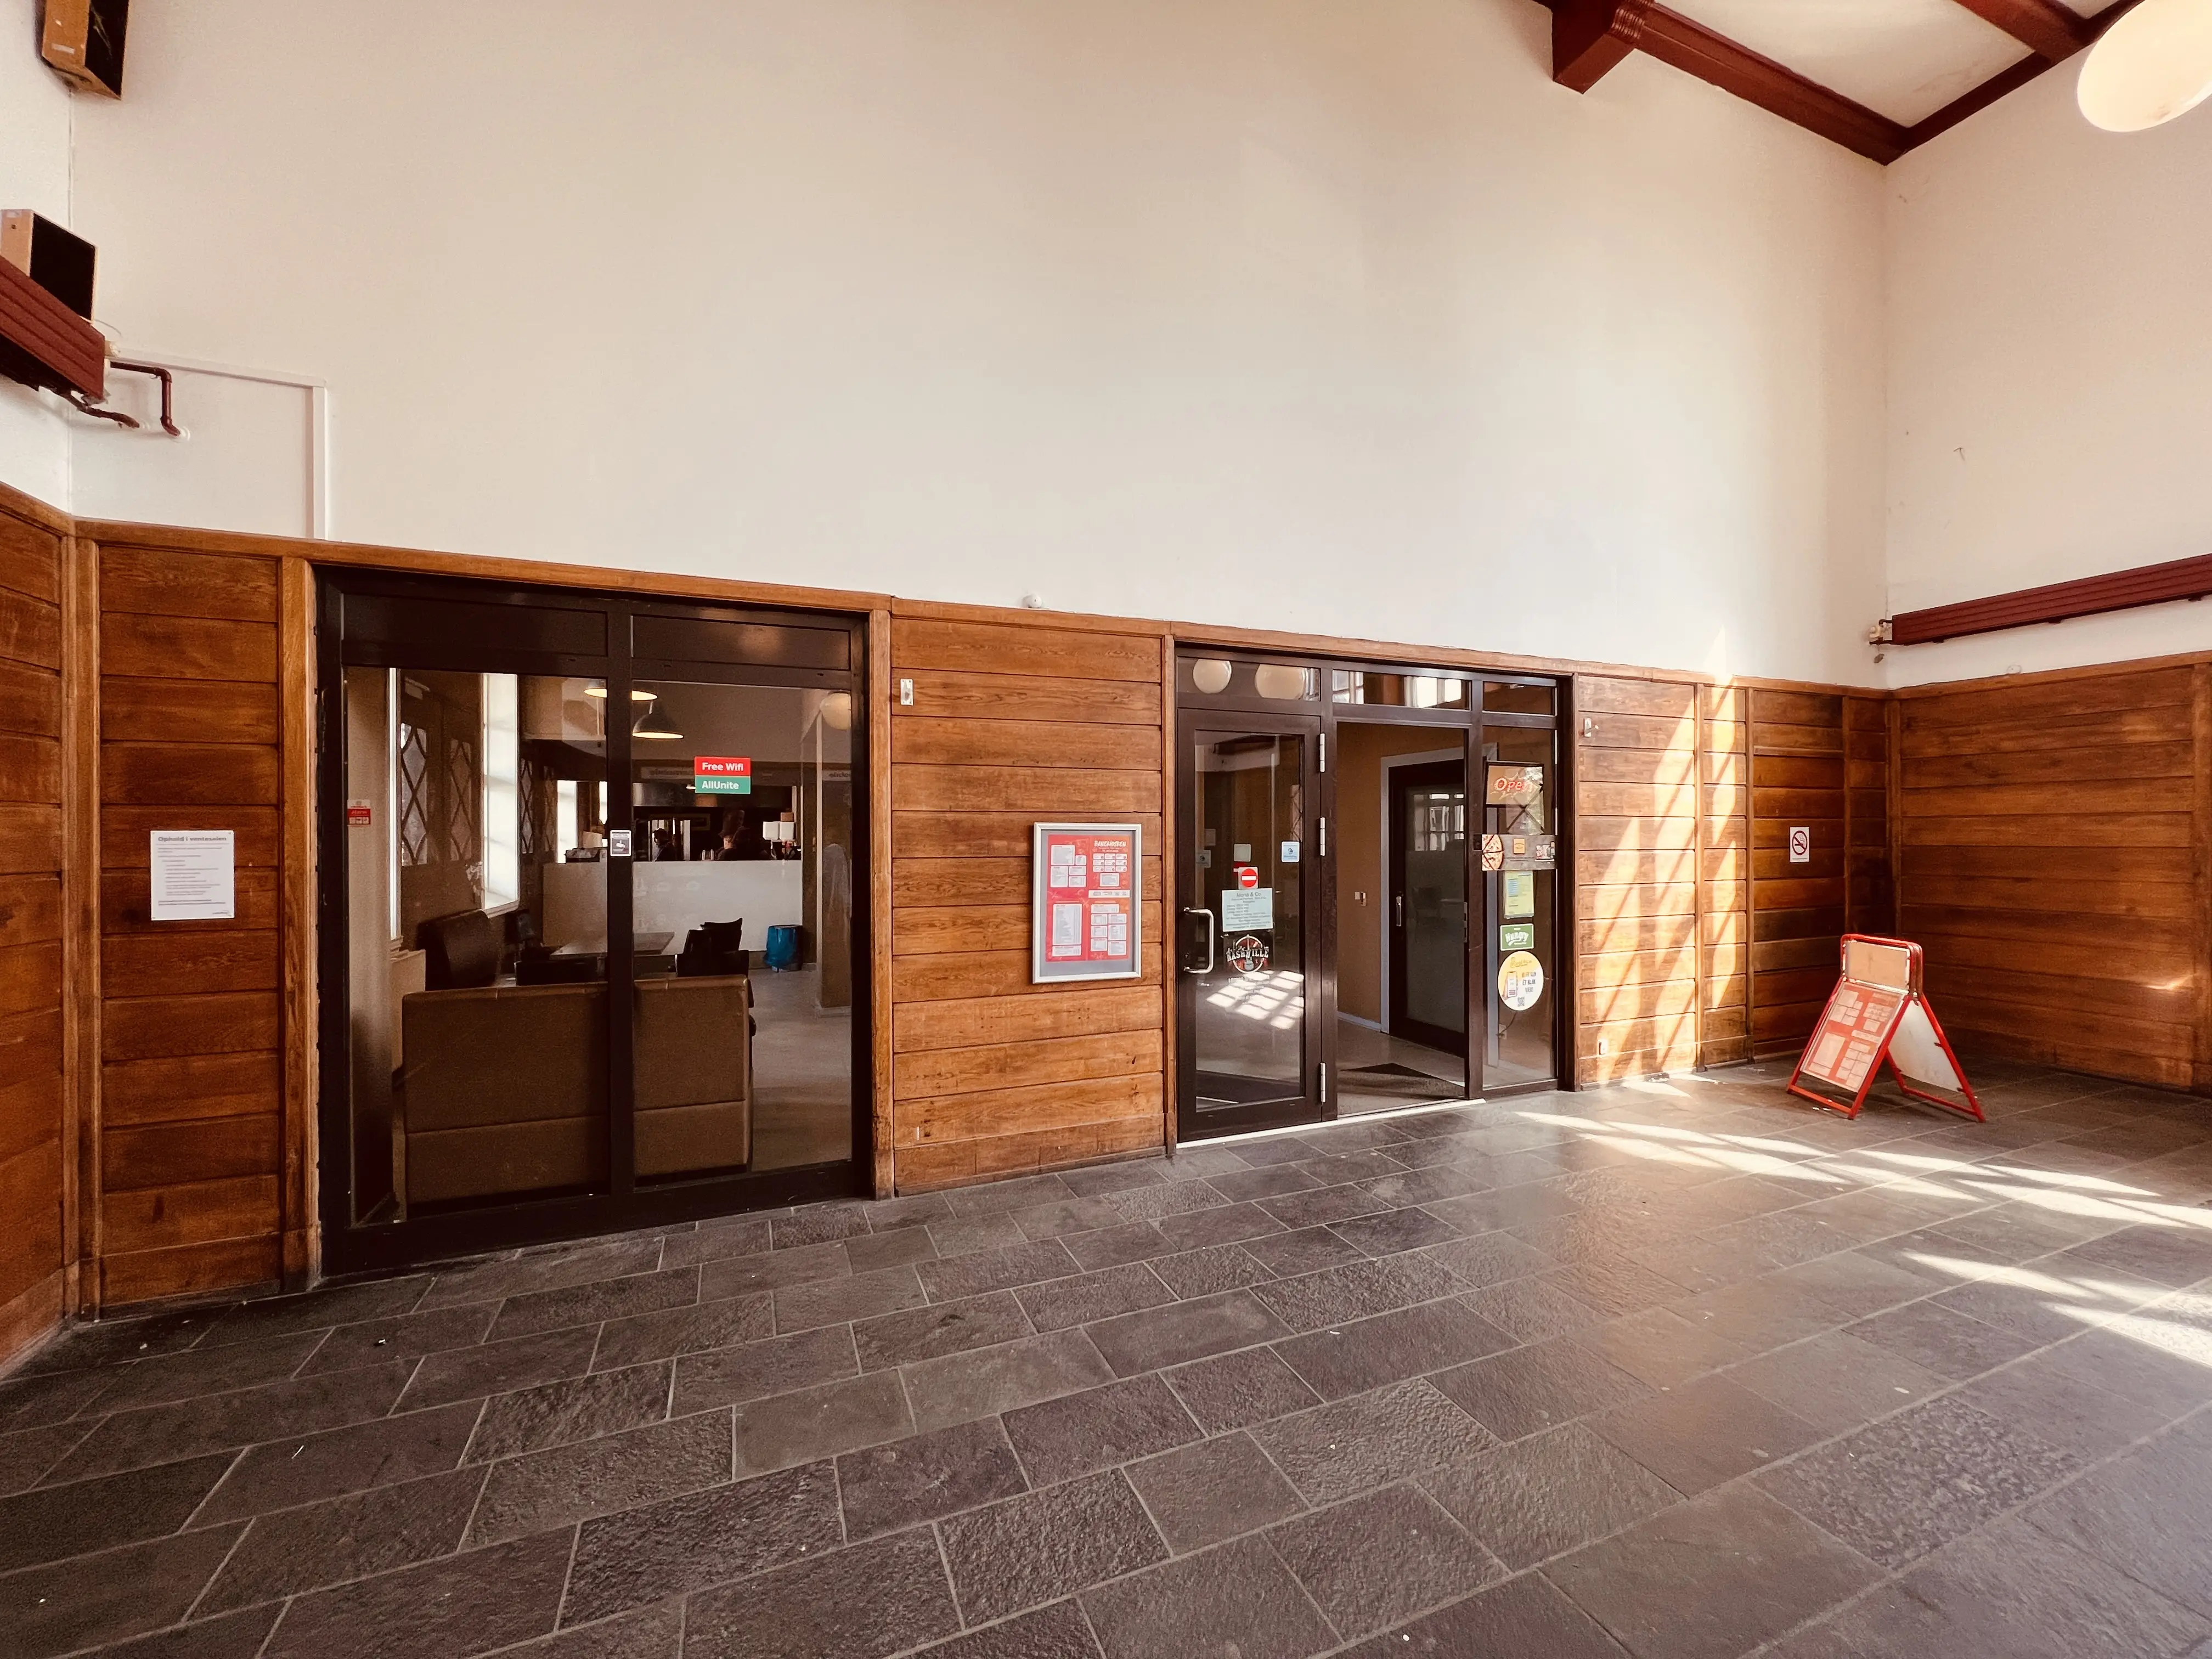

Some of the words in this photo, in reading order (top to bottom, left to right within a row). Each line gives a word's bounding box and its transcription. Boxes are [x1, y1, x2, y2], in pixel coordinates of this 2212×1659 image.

[702, 762, 724, 771] Free
[725, 763, 744, 771] Wifi
[702, 781, 740, 789] AllUnite
[1493, 777, 1533, 793] Open
[1226, 946, 1269, 962] NASHVILLE
